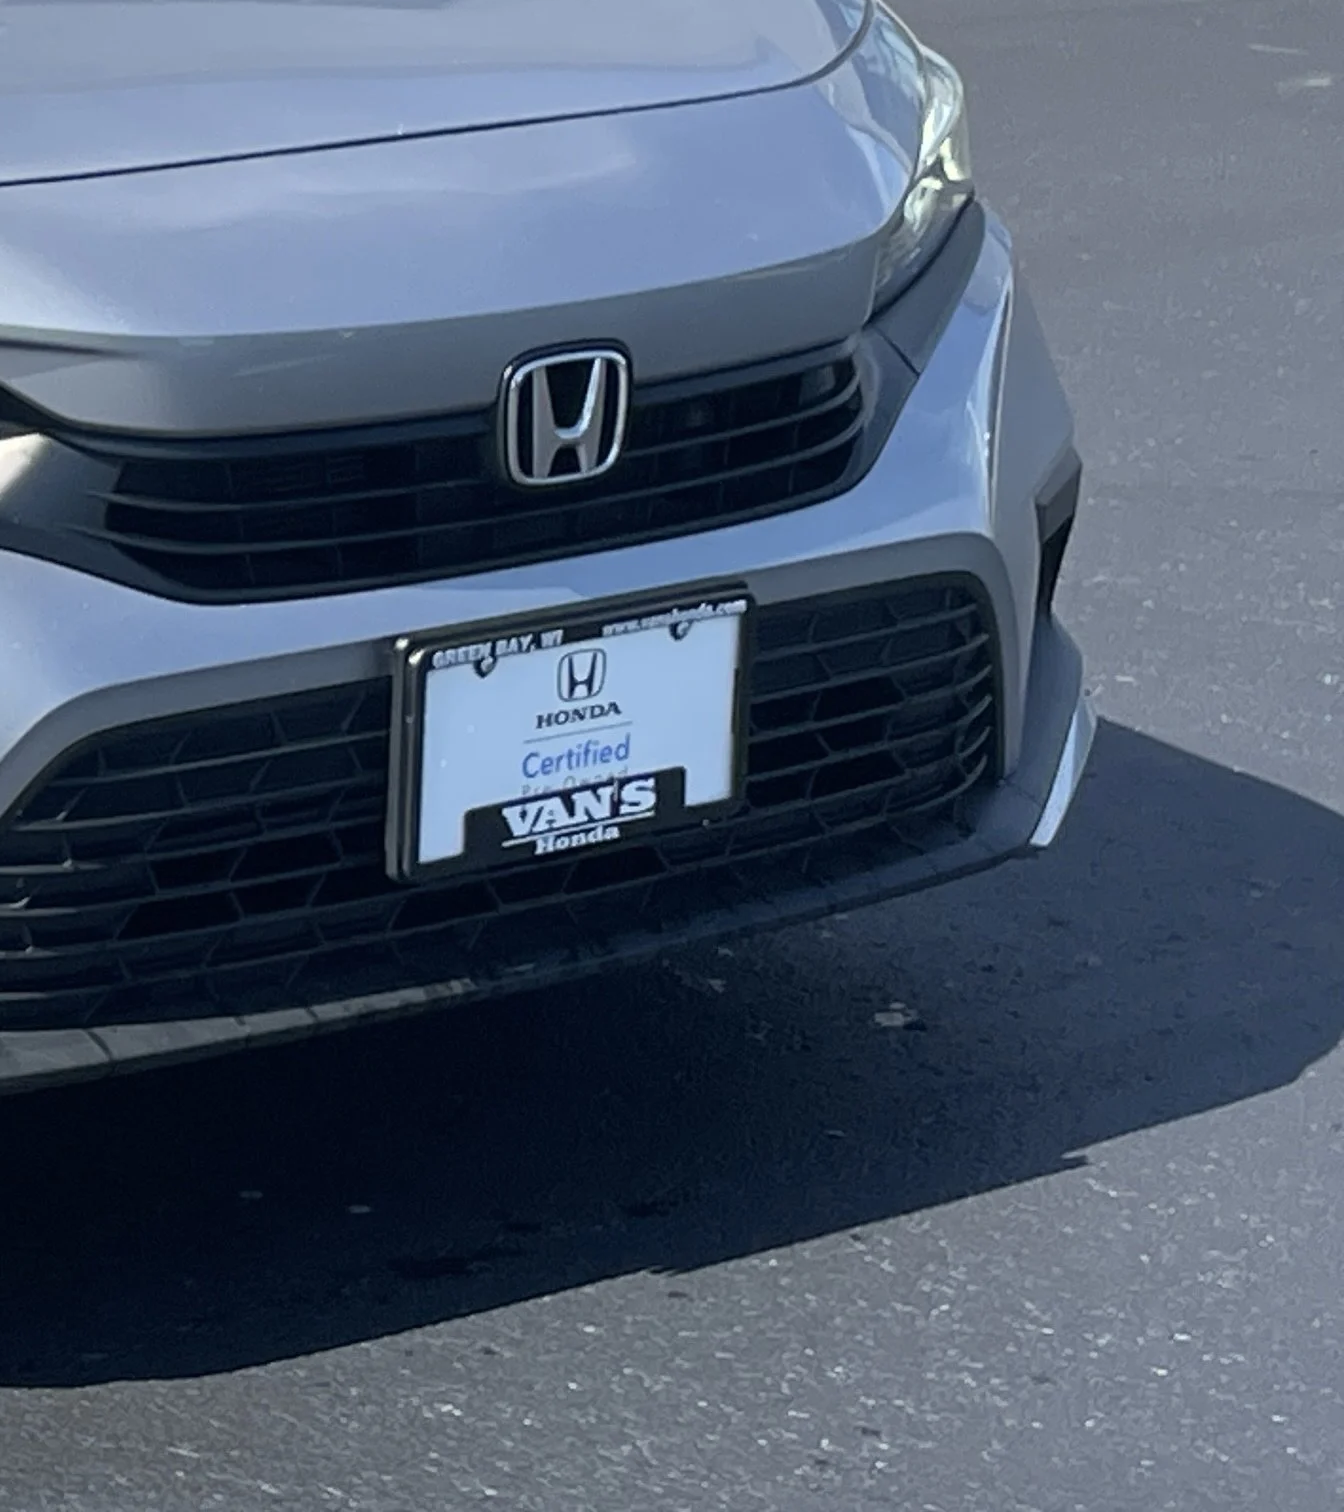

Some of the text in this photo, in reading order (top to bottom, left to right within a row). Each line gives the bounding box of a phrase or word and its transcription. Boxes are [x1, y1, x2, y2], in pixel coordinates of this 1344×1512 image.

[433, 641, 492, 669] GREEN
[540, 629, 564, 649] WI
[536, 701, 622, 729] HONDA
[522, 732, 631, 778] Certified
[534, 825, 620, 855] Honda
